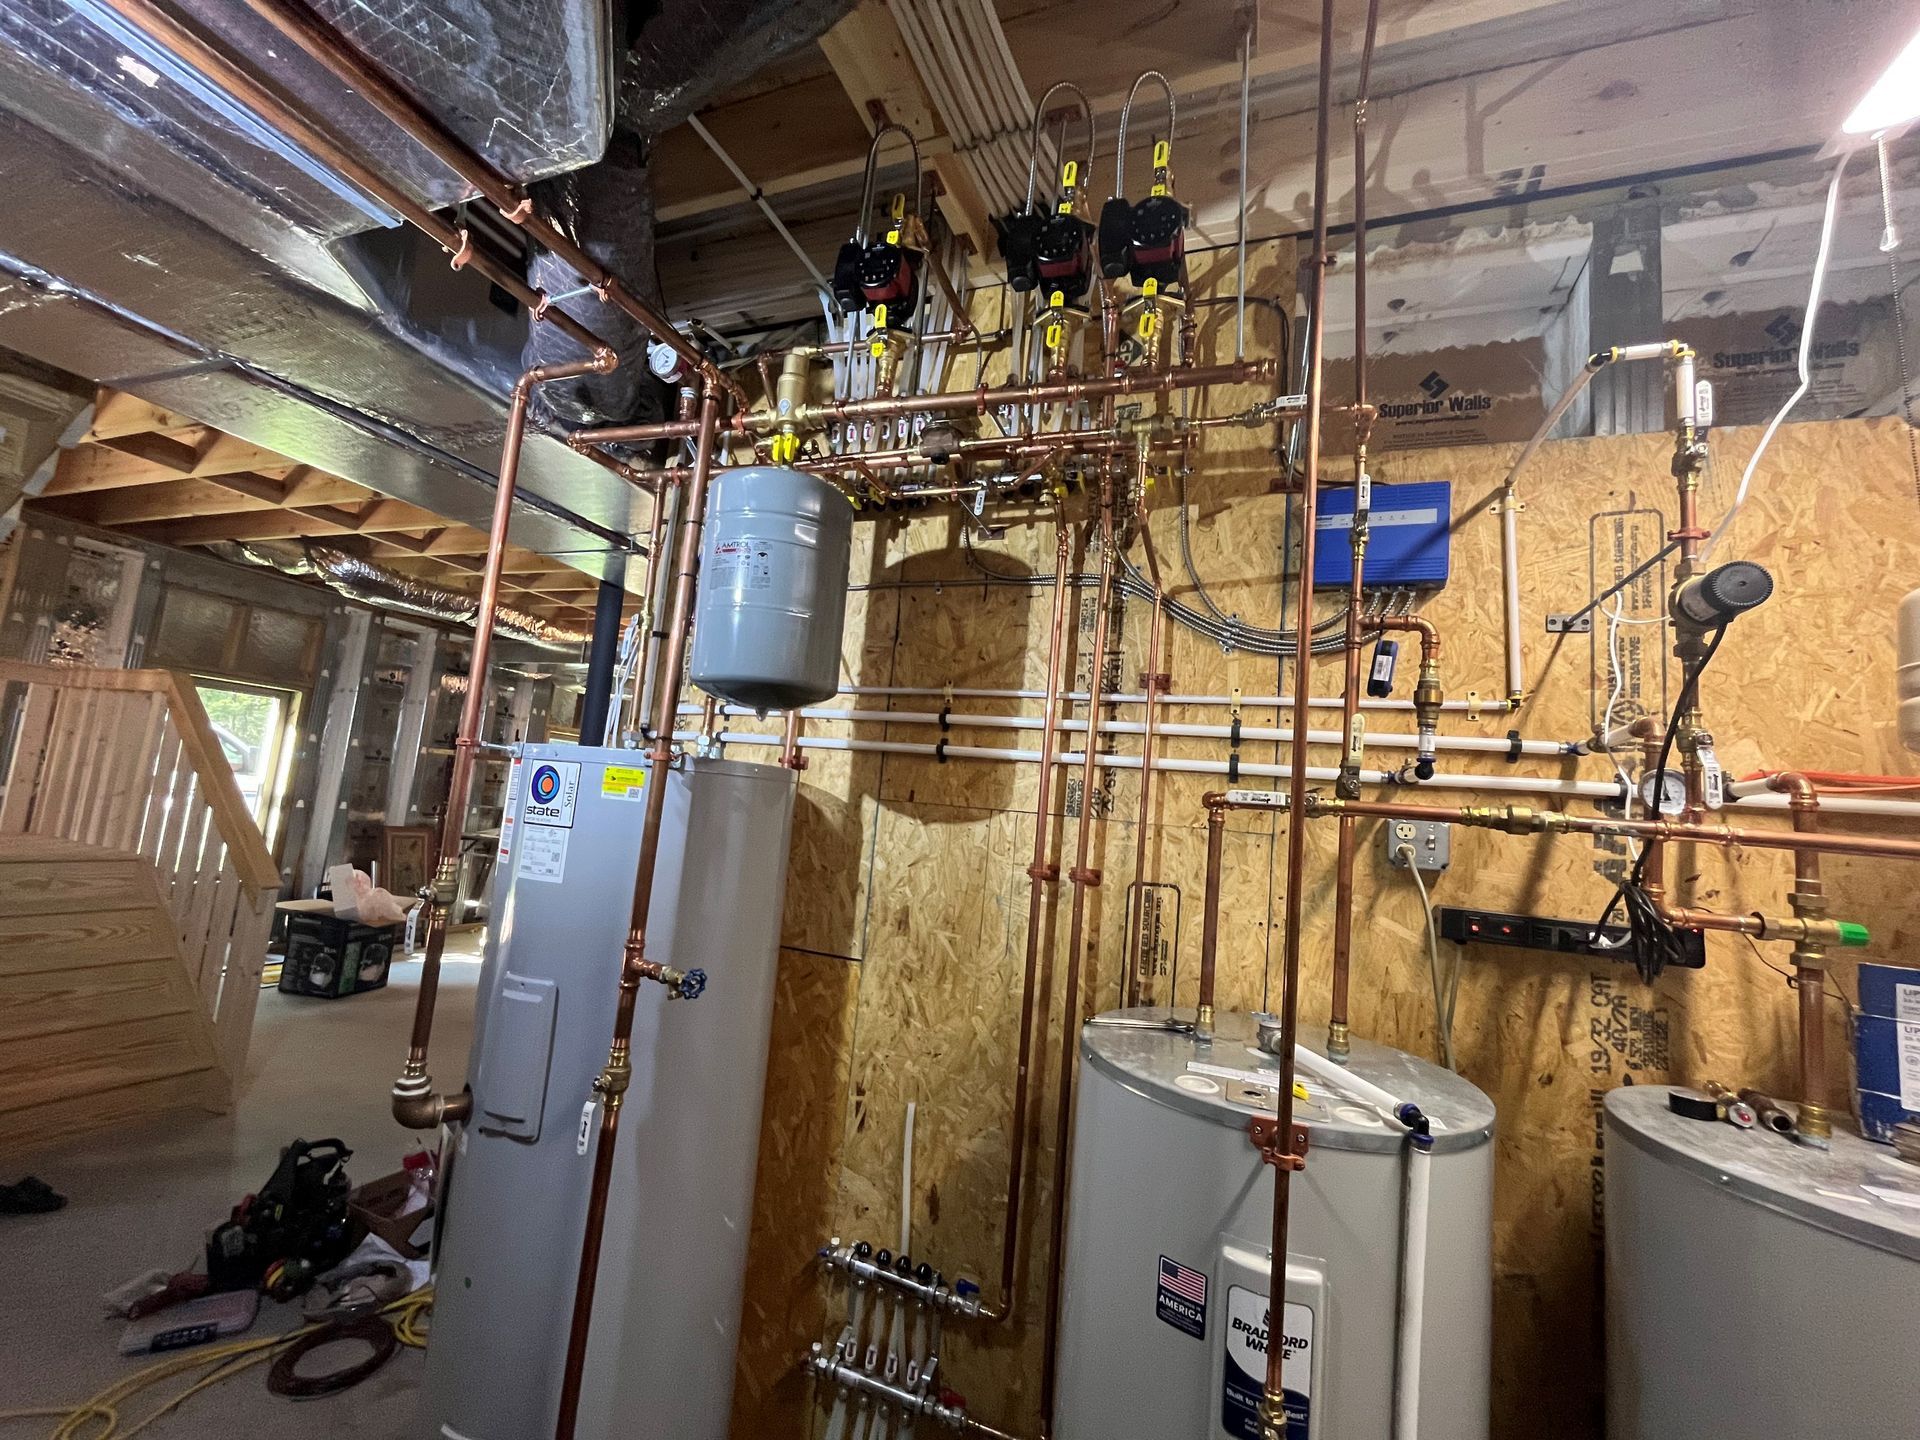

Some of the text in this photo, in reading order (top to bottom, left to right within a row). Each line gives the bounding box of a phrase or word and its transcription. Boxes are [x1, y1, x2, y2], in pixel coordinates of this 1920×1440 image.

[1379, 395, 1492, 419] Superior Walls
[721, 541, 750, 549] AMTROL
[564, 781, 576, 808] Solar
[526, 805, 560, 818] state
[1590, 972, 1611, 1007] CAT
[1159, 1294, 1203, 1323] AMERICA
[1232, 1317, 1309, 1350] BRADORD
[1245, 1335, 1292, 1360] WHE
[1226, 1387, 1304, 1420] Built to Best
